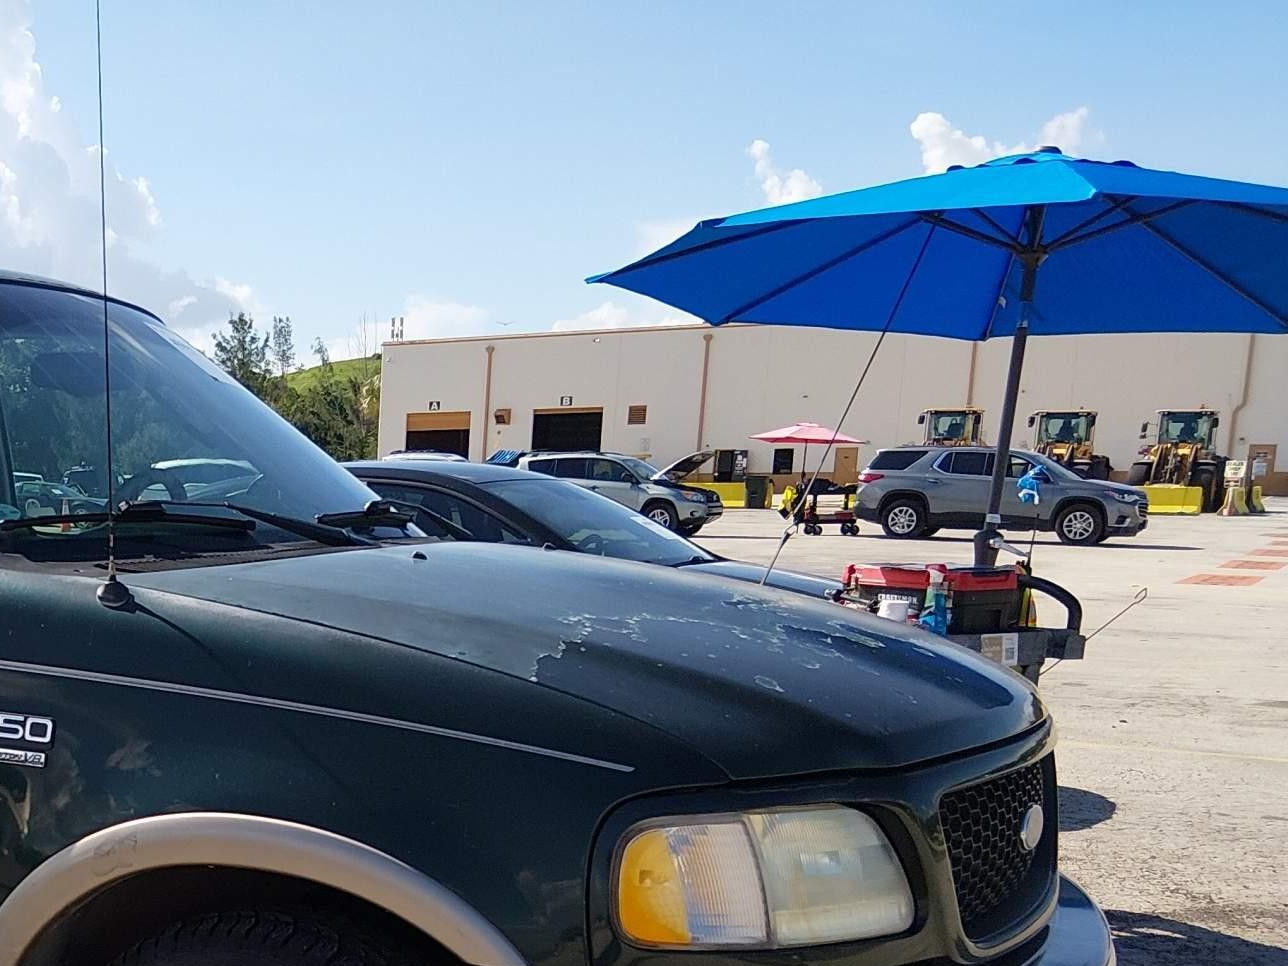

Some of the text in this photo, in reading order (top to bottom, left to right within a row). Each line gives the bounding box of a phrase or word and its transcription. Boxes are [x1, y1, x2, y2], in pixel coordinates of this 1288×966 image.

[430, 401, 439, 410] A
[562, 397, 571, 406] B
[24, 752, 43, 765] V8
